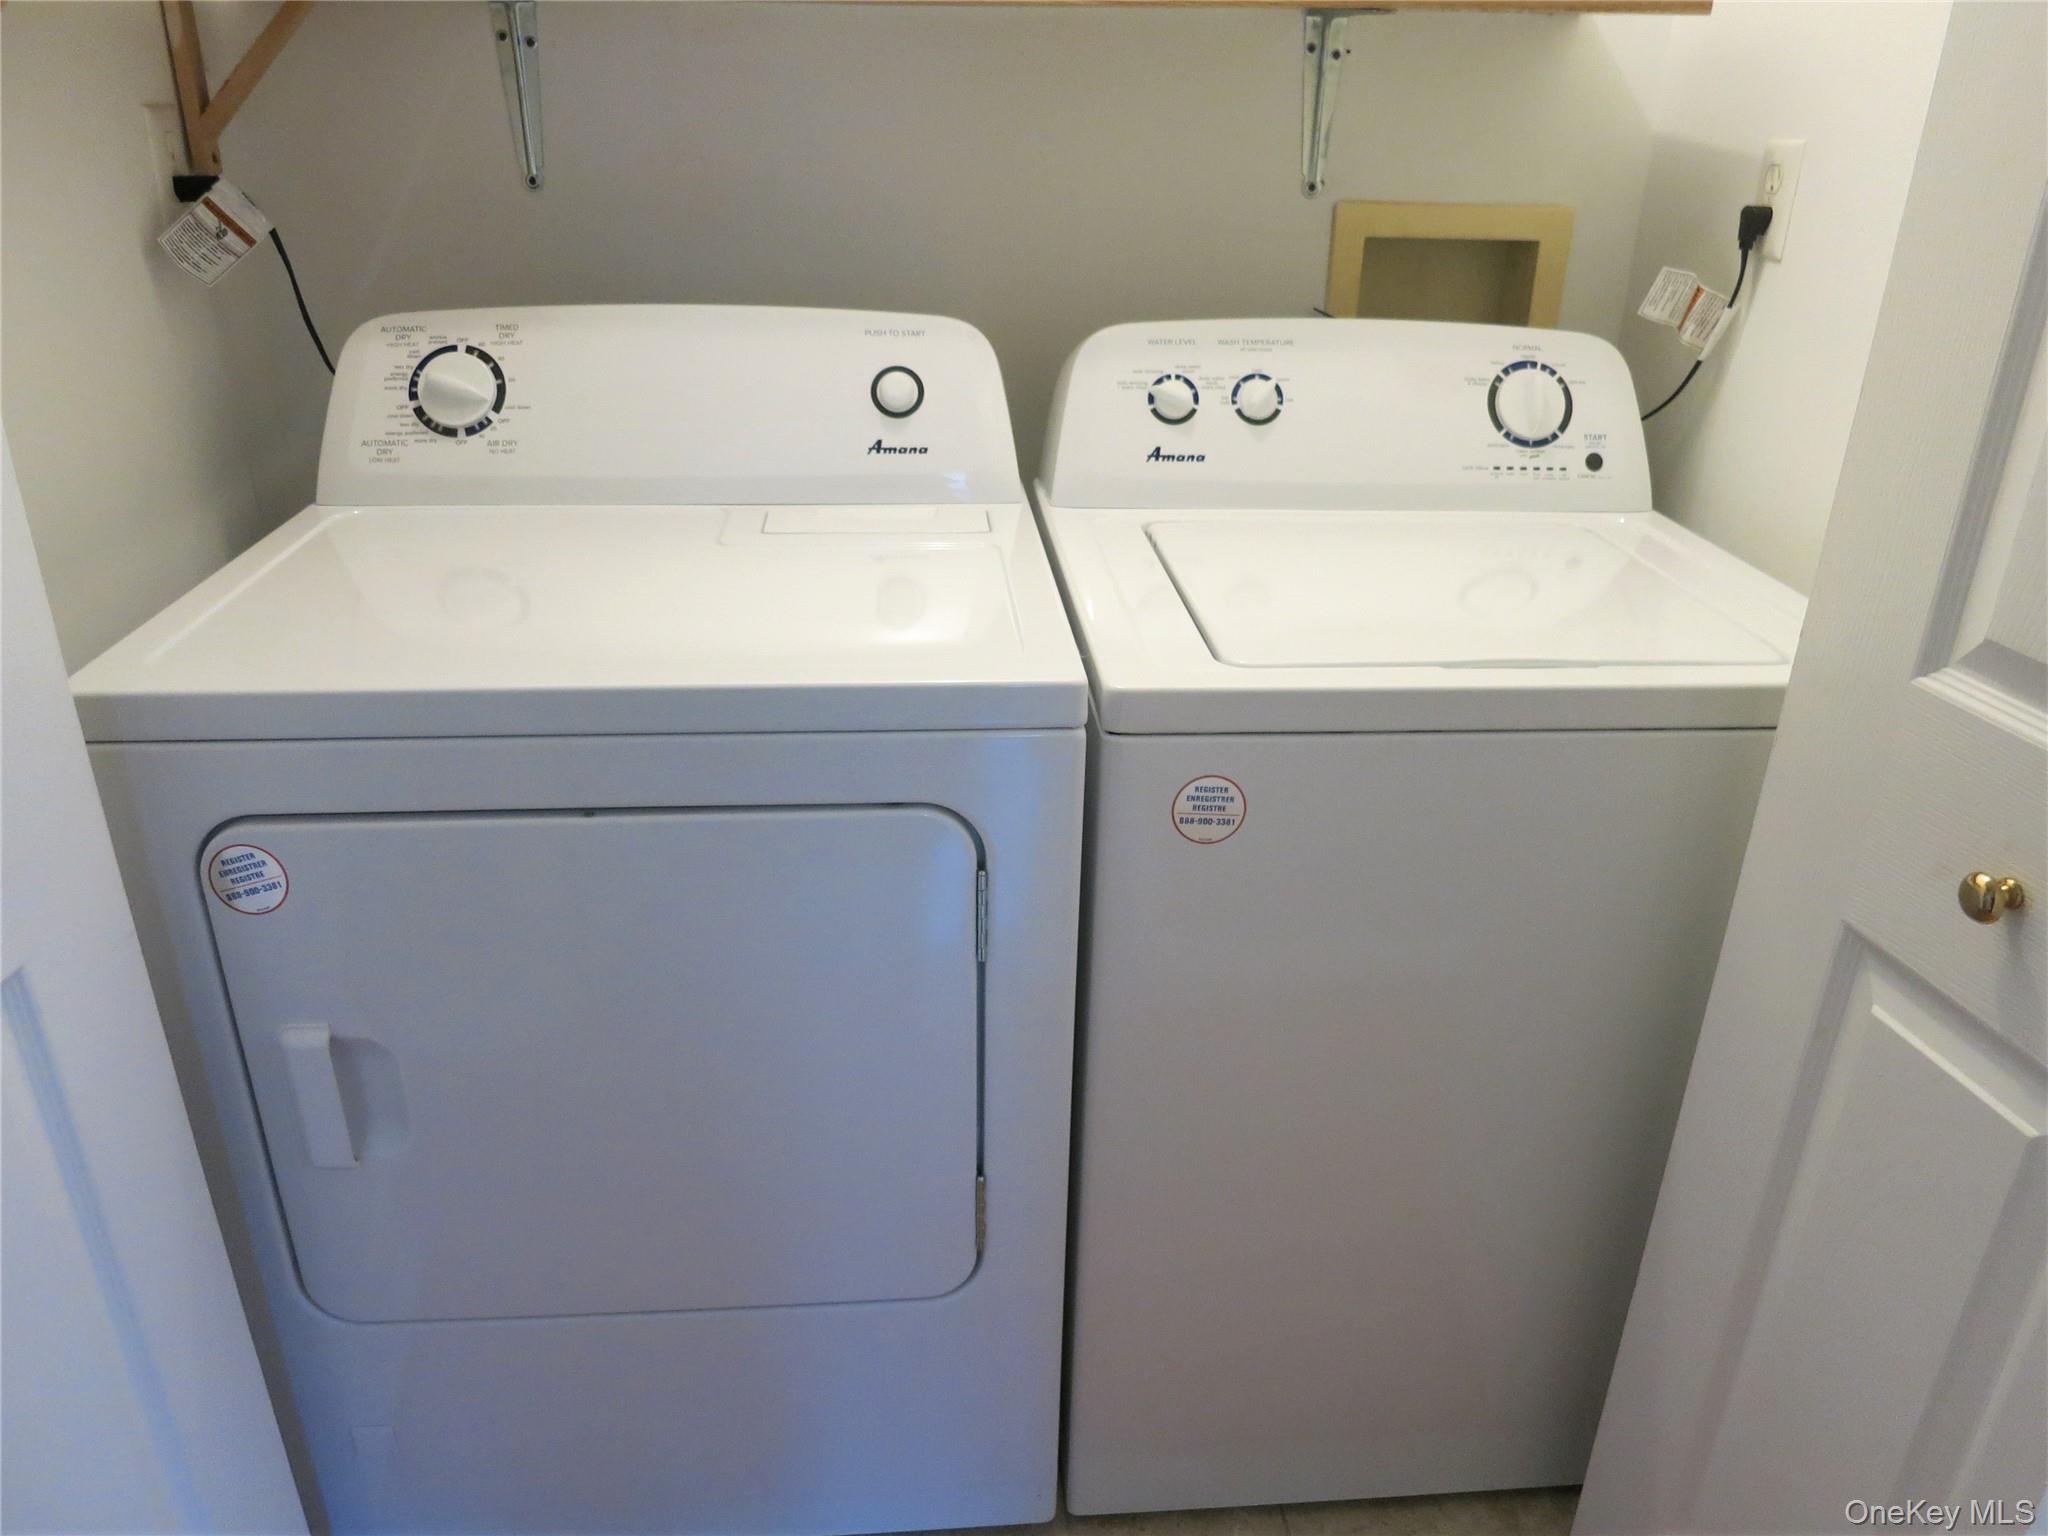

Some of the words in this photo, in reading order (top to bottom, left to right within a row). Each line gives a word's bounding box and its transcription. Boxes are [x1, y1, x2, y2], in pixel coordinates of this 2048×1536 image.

[380, 325, 427, 334] AUTOMATIC
[495, 323, 520, 332] TIMED
[498, 332, 515, 340] DRY
[864, 329, 887, 337] PUSH
[889, 329, 899, 337] TO
[901, 329, 926, 337] START
[1148, 338, 1173, 346] WATER
[1174, 338, 1196, 346] LEVEL
[1241, 339, 1294, 347] TEMPERATURE
[361, 440, 408, 448] AUTOMATIC
[867, 439, 928, 455] Amana
[376, 448, 393, 456] DRY
[1146, 446, 1206, 463] Amana
[1186, 795, 1235, 803] ENREGISTRER
[220, 852, 257, 866] REGISTER
[219, 860, 267, 878] ENREGISTRER
